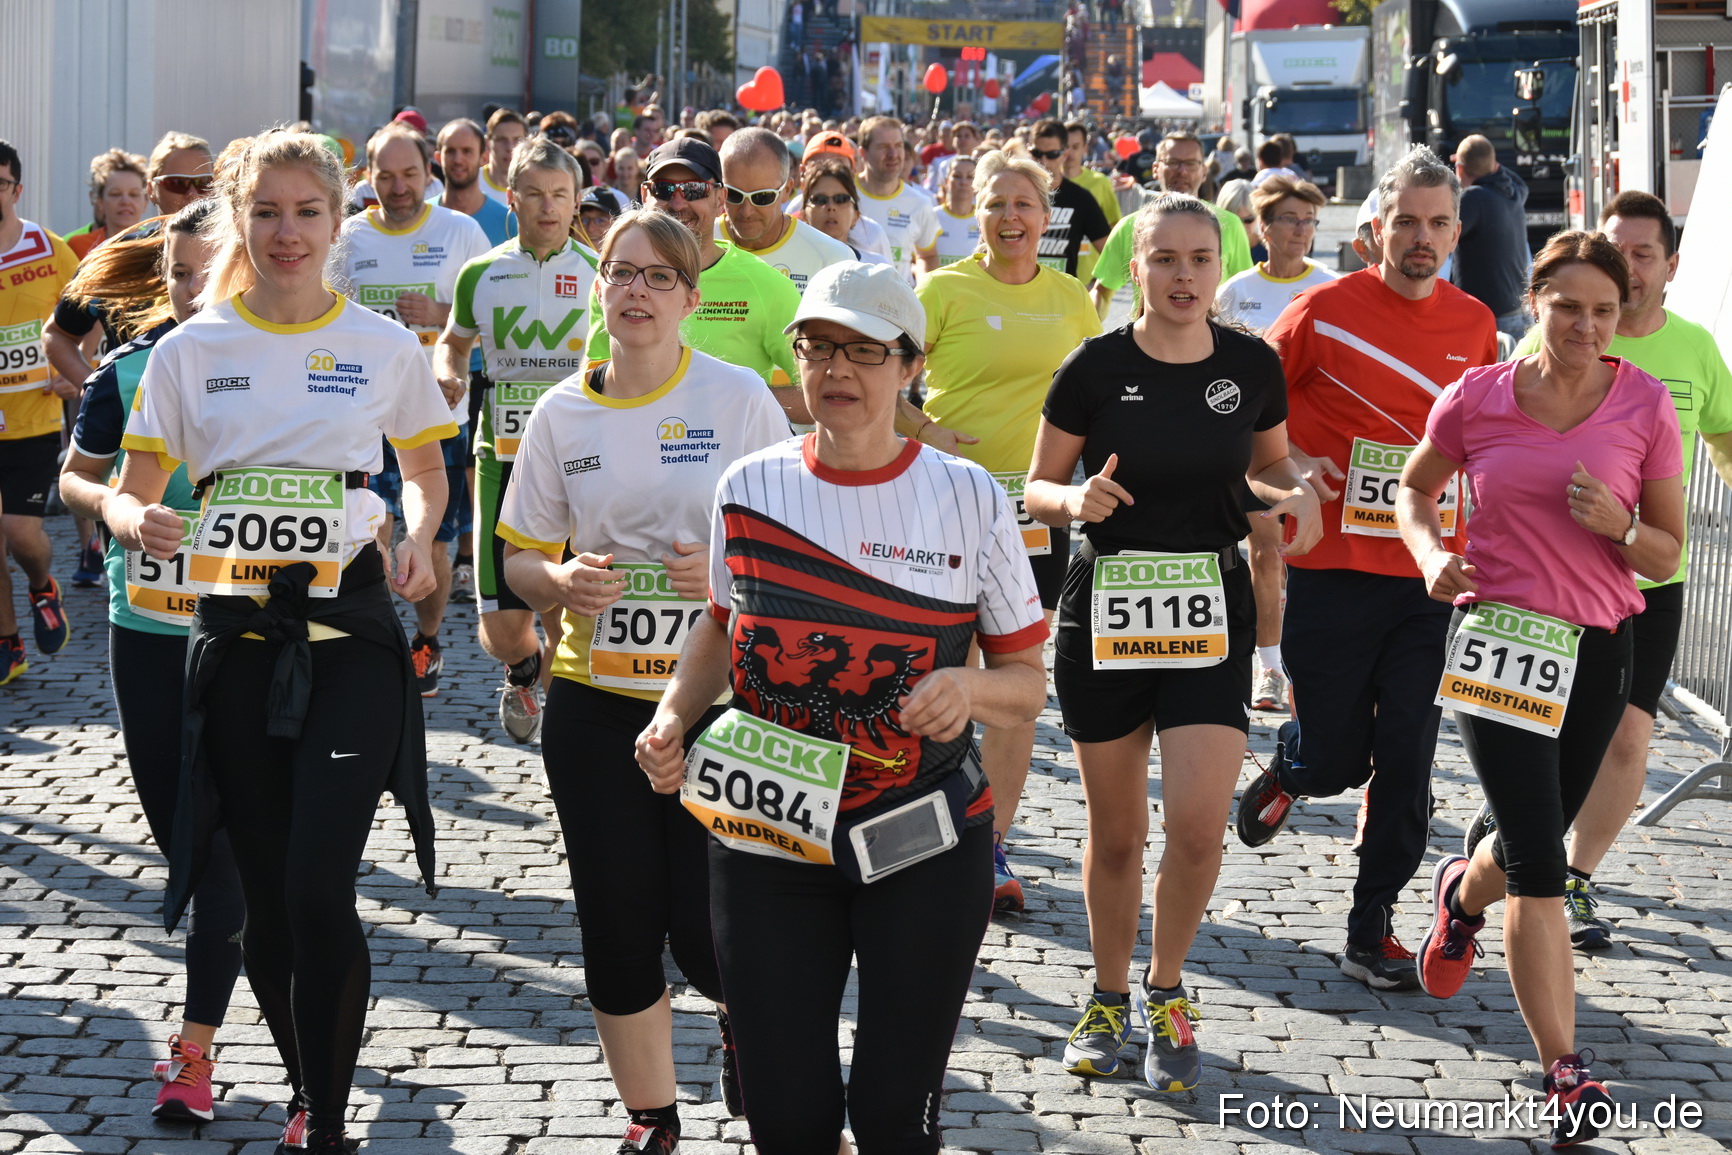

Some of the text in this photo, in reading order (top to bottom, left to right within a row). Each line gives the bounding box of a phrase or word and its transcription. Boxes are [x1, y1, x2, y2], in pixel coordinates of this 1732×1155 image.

[927, 24, 996, 41] START
[413, 244, 427, 253] 20
[10, 264, 58, 287] BÖGL
[0, 346, 39, 371] 099
[309, 354, 360, 372] 20 JAHRE
[497, 357, 579, 368] KW ENERGIE
[207, 377, 250, 389] BOCK
[307, 384, 357, 397] Stadtlauf
[308, 373, 369, 386] Neumarkter
[660, 423, 712, 440] 20 JAHRE
[660, 441, 721, 452] Neumarkter
[1360, 445, 1408, 470] BO
[564, 455, 601, 472] BOCK
[660, 453, 709, 464] Stadtlauf
[217, 473, 334, 504] BOCK
[1359, 475, 1401, 506] 50
[1354, 510, 1395, 523] MARK
[208, 512, 328, 553] 5069
[859, 542, 946, 567] NEUMARKT
[140, 551, 184, 586] 51
[231, 564, 281, 581] LIND
[1103, 559, 1213, 586] BOCK
[167, 596, 197, 613] LIS
[1108, 594, 1212, 630] 5118
[1474, 606, 1571, 652] BOCK
[1113, 640, 1209, 656] MARLENE
[1459, 638, 1560, 693] 5119
[1451, 680, 1553, 719] CHRISTIANE
[705, 719, 831, 782] BOCK
[697, 758, 814, 835] 5084
[712, 816, 807, 857] ANDREA
